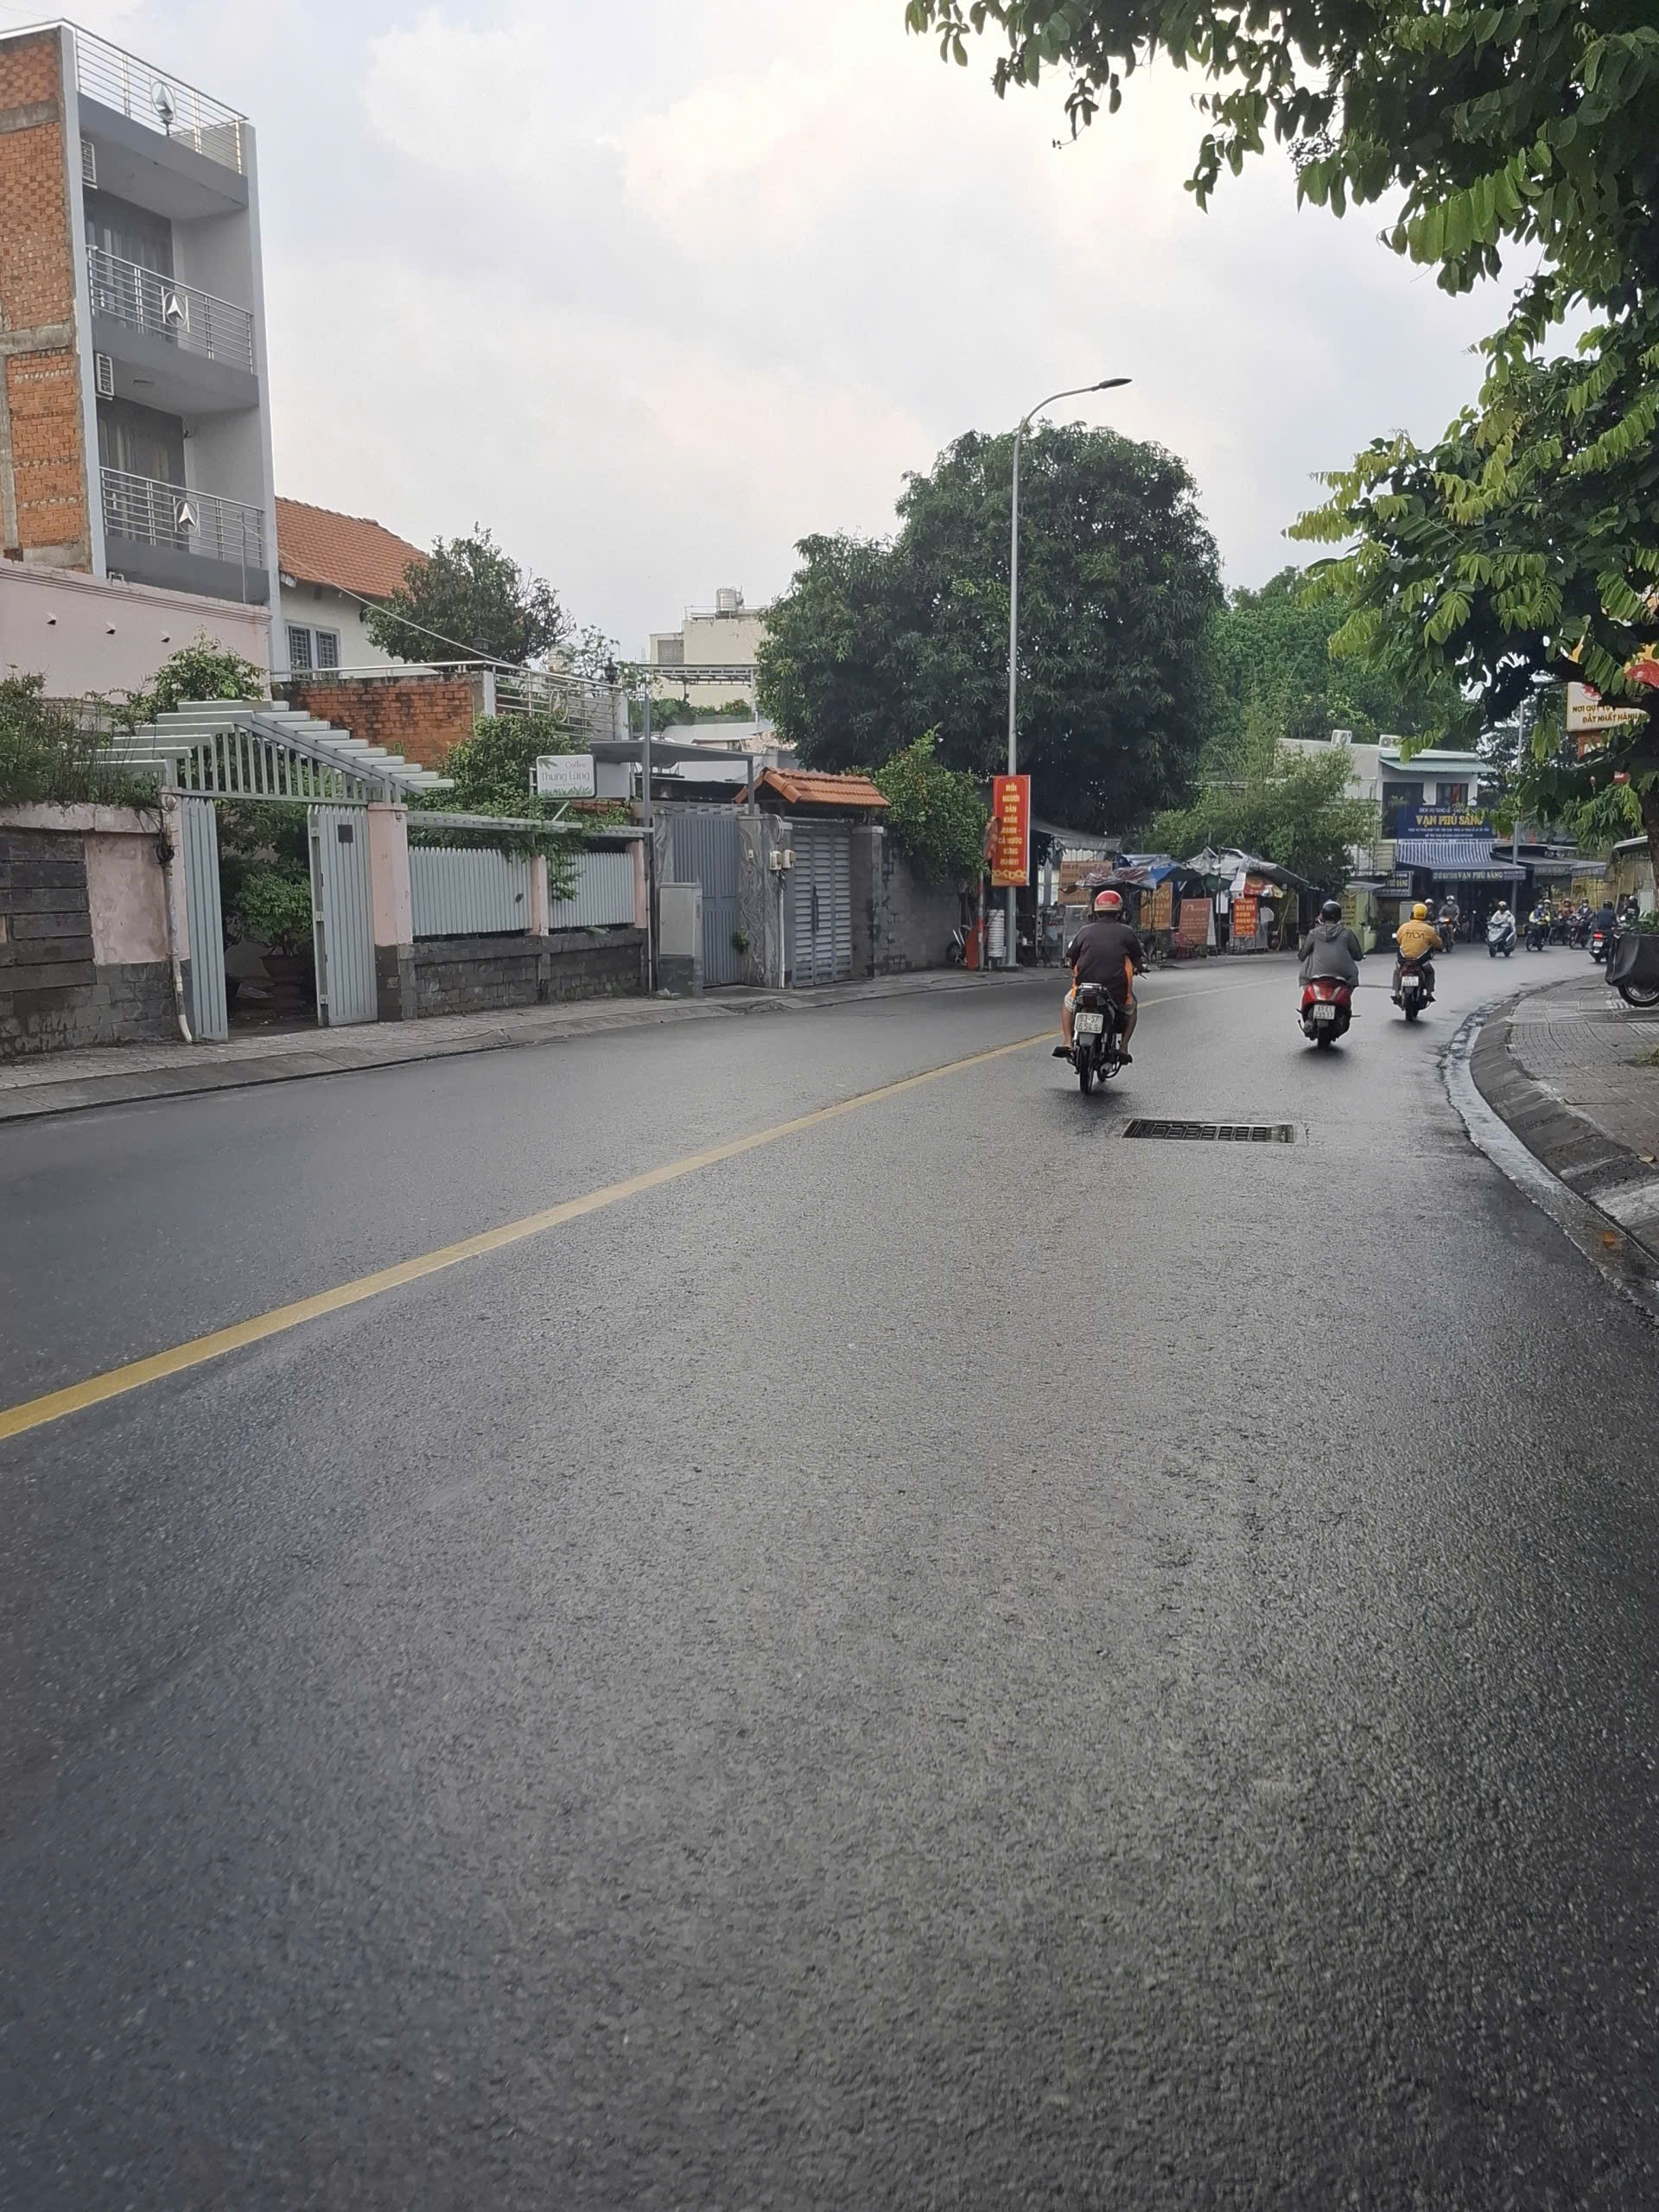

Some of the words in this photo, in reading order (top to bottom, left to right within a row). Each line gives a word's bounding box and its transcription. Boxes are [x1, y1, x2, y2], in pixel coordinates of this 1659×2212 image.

[540, 772, 567, 783] Thung
[1415, 815, 1437, 828] VẠN
[1439, 813, 1458, 826] PHÚ
